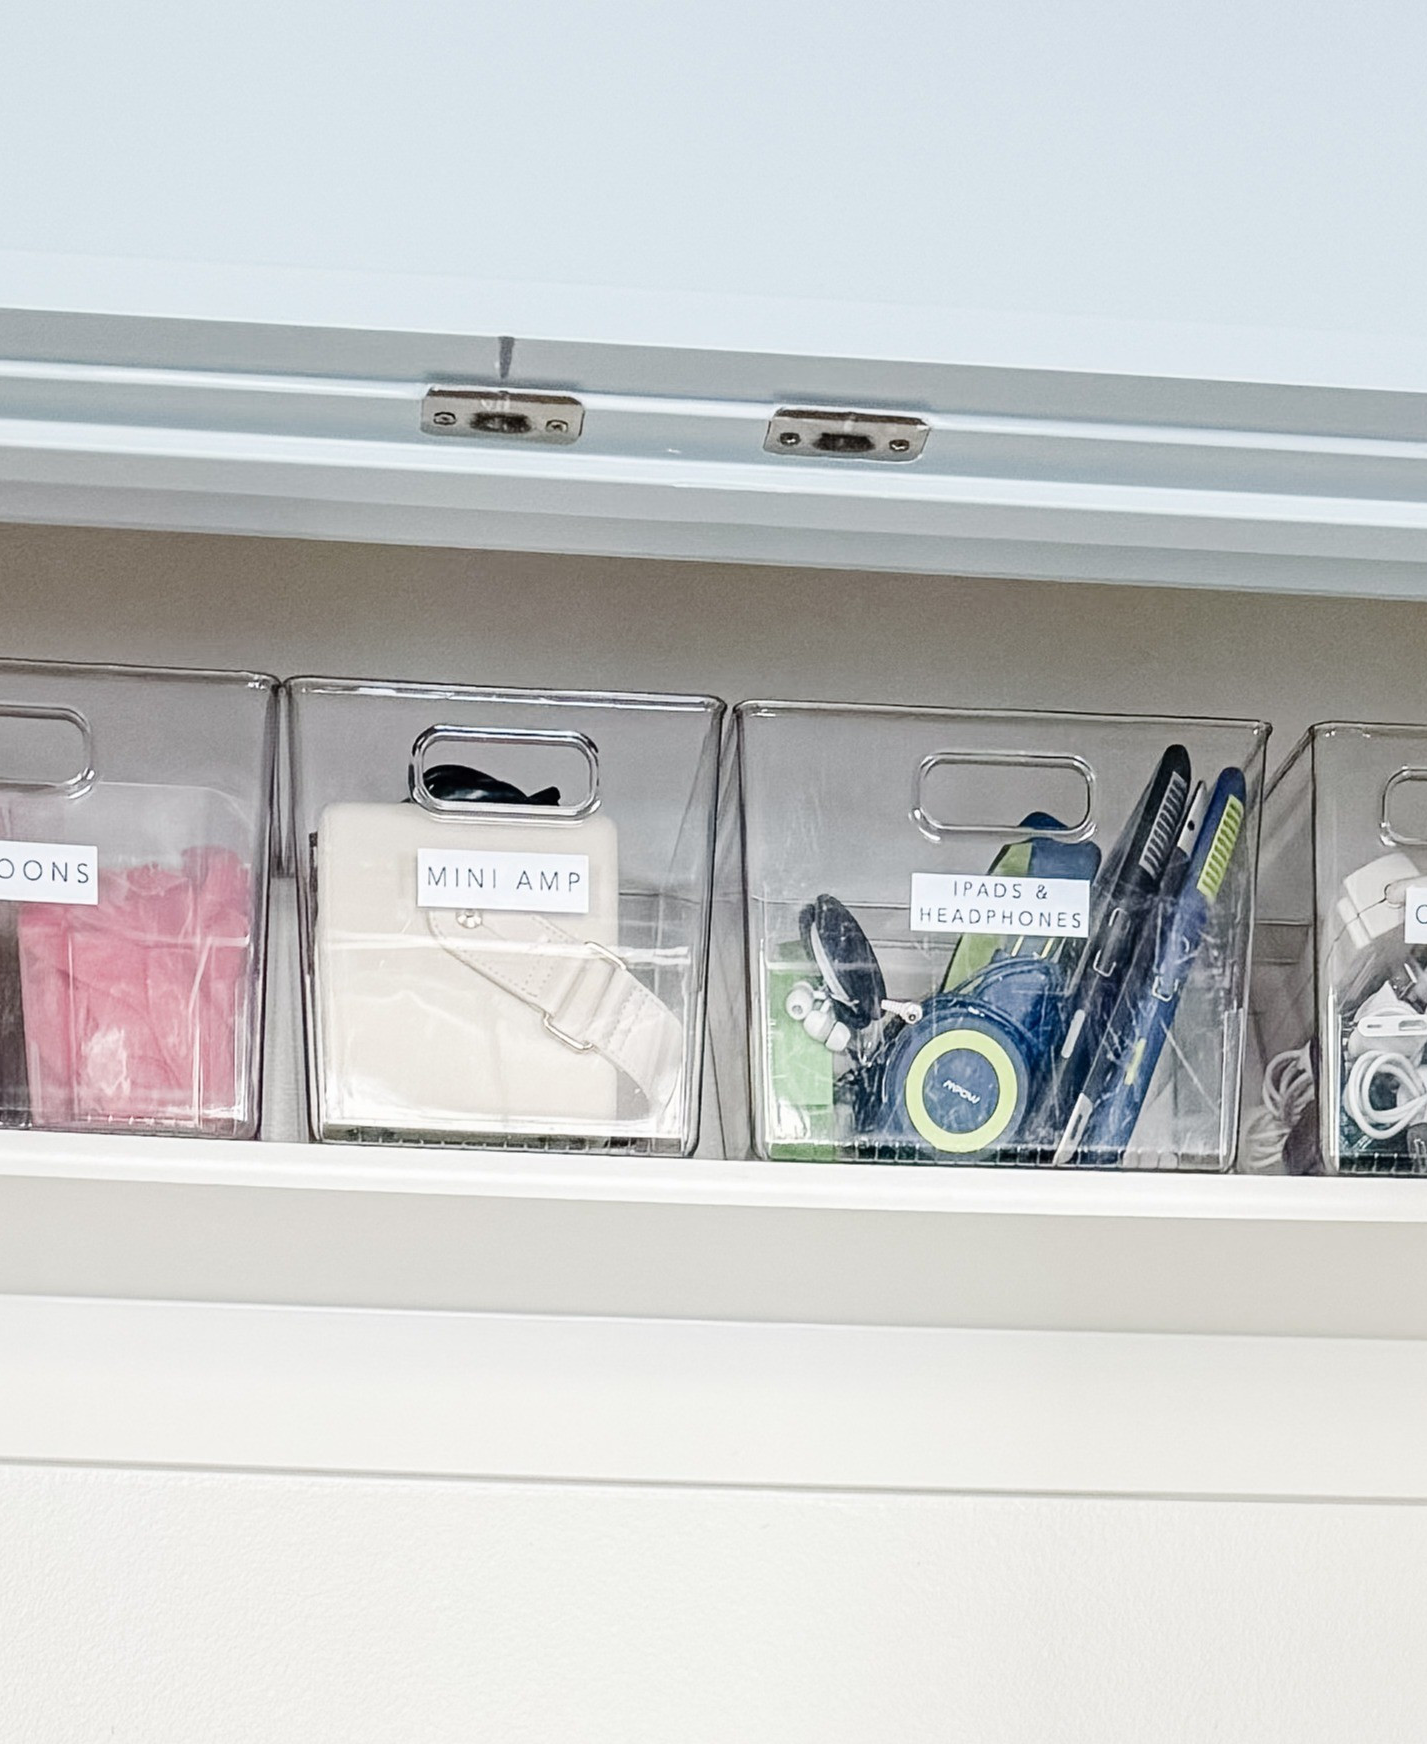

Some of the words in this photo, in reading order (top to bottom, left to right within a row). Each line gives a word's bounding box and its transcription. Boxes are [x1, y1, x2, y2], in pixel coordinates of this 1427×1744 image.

[427, 865, 497, 889] MINI
[515, 869, 581, 893] AMP
[953, 880, 1022, 900] IPADS
[1035, 884, 1048, 900] &
[919, 907, 1081, 929] HEADPHONES
